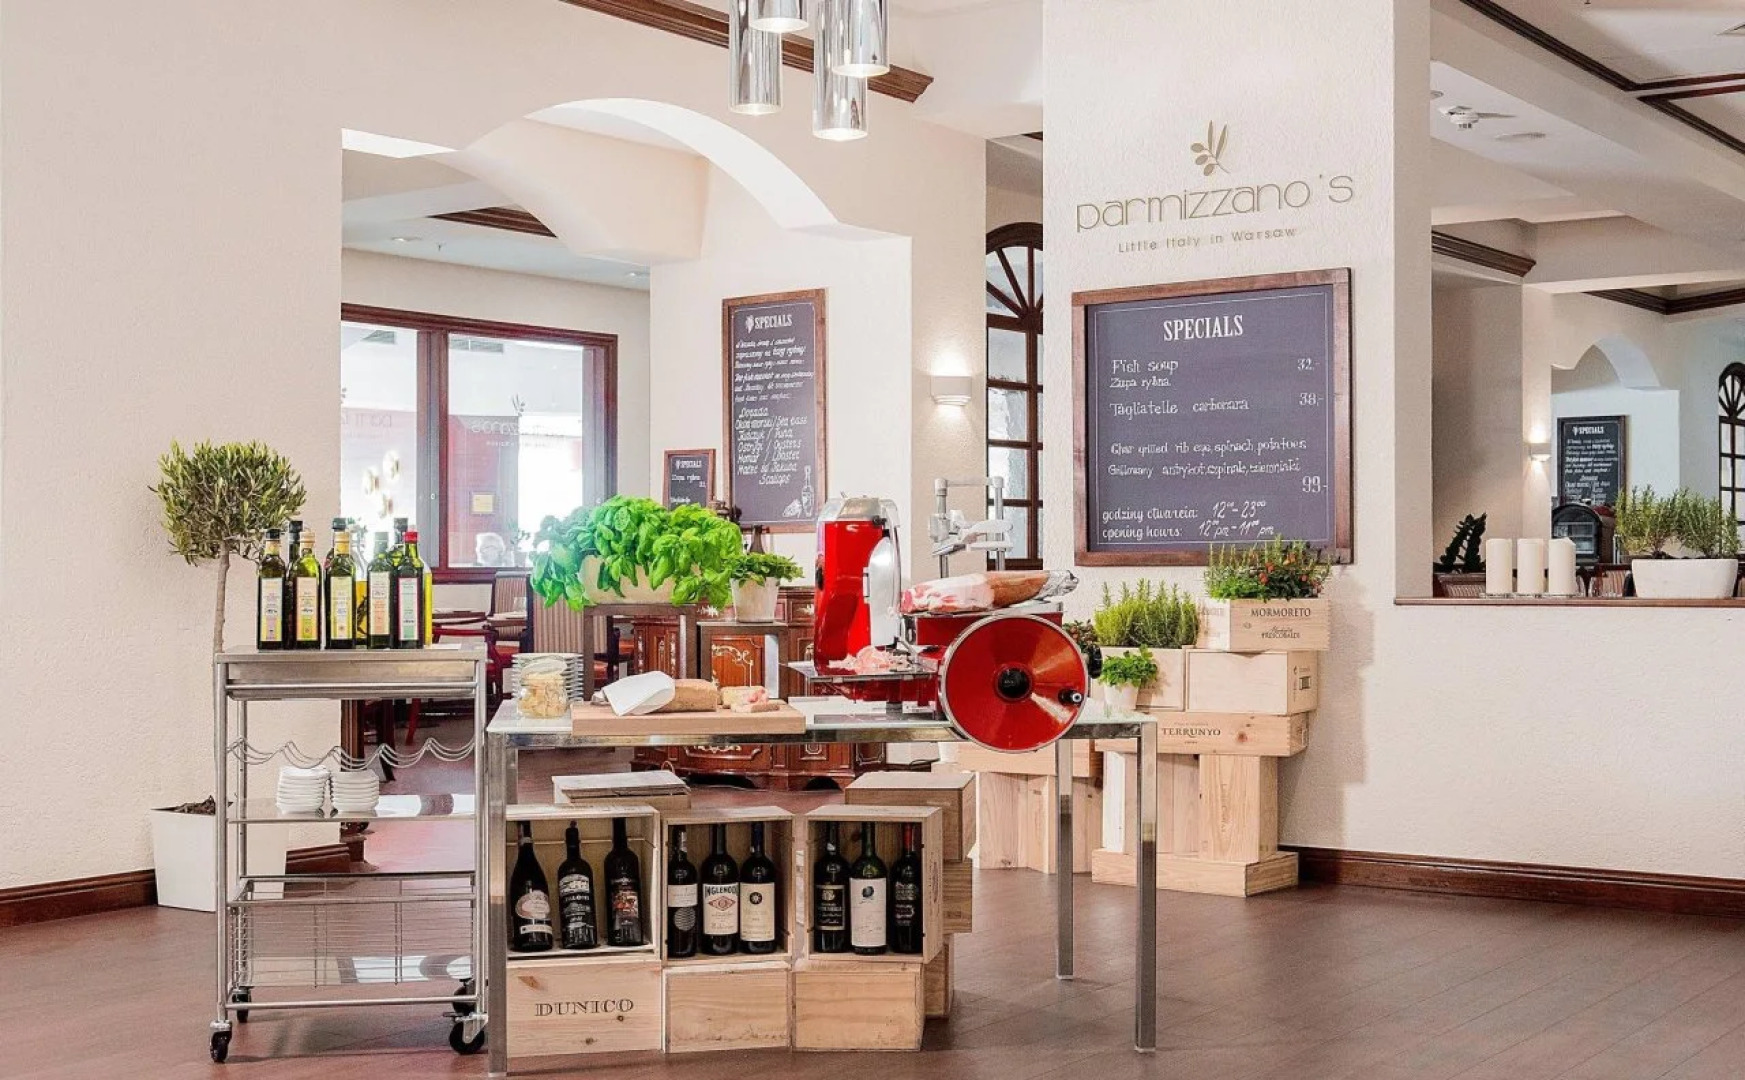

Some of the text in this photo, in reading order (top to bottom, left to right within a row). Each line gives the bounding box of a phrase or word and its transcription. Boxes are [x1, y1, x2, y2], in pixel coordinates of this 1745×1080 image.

[1118, 227, 1298, 253] Little Italy in Warsaw
[754, 314, 793, 330] SPECIALS
[1163, 314, 1244, 342] SPECIALS
[1112, 359, 1179, 375] Fish soup
[1110, 377, 1138, 391] Zupa
[1109, 400, 1179, 420] Tagliatelle
[1250, 607, 1312, 618] MORMORETO
[1161, 727, 1222, 739] TERRUNYO
[534, 998, 635, 1017] DUNICO
